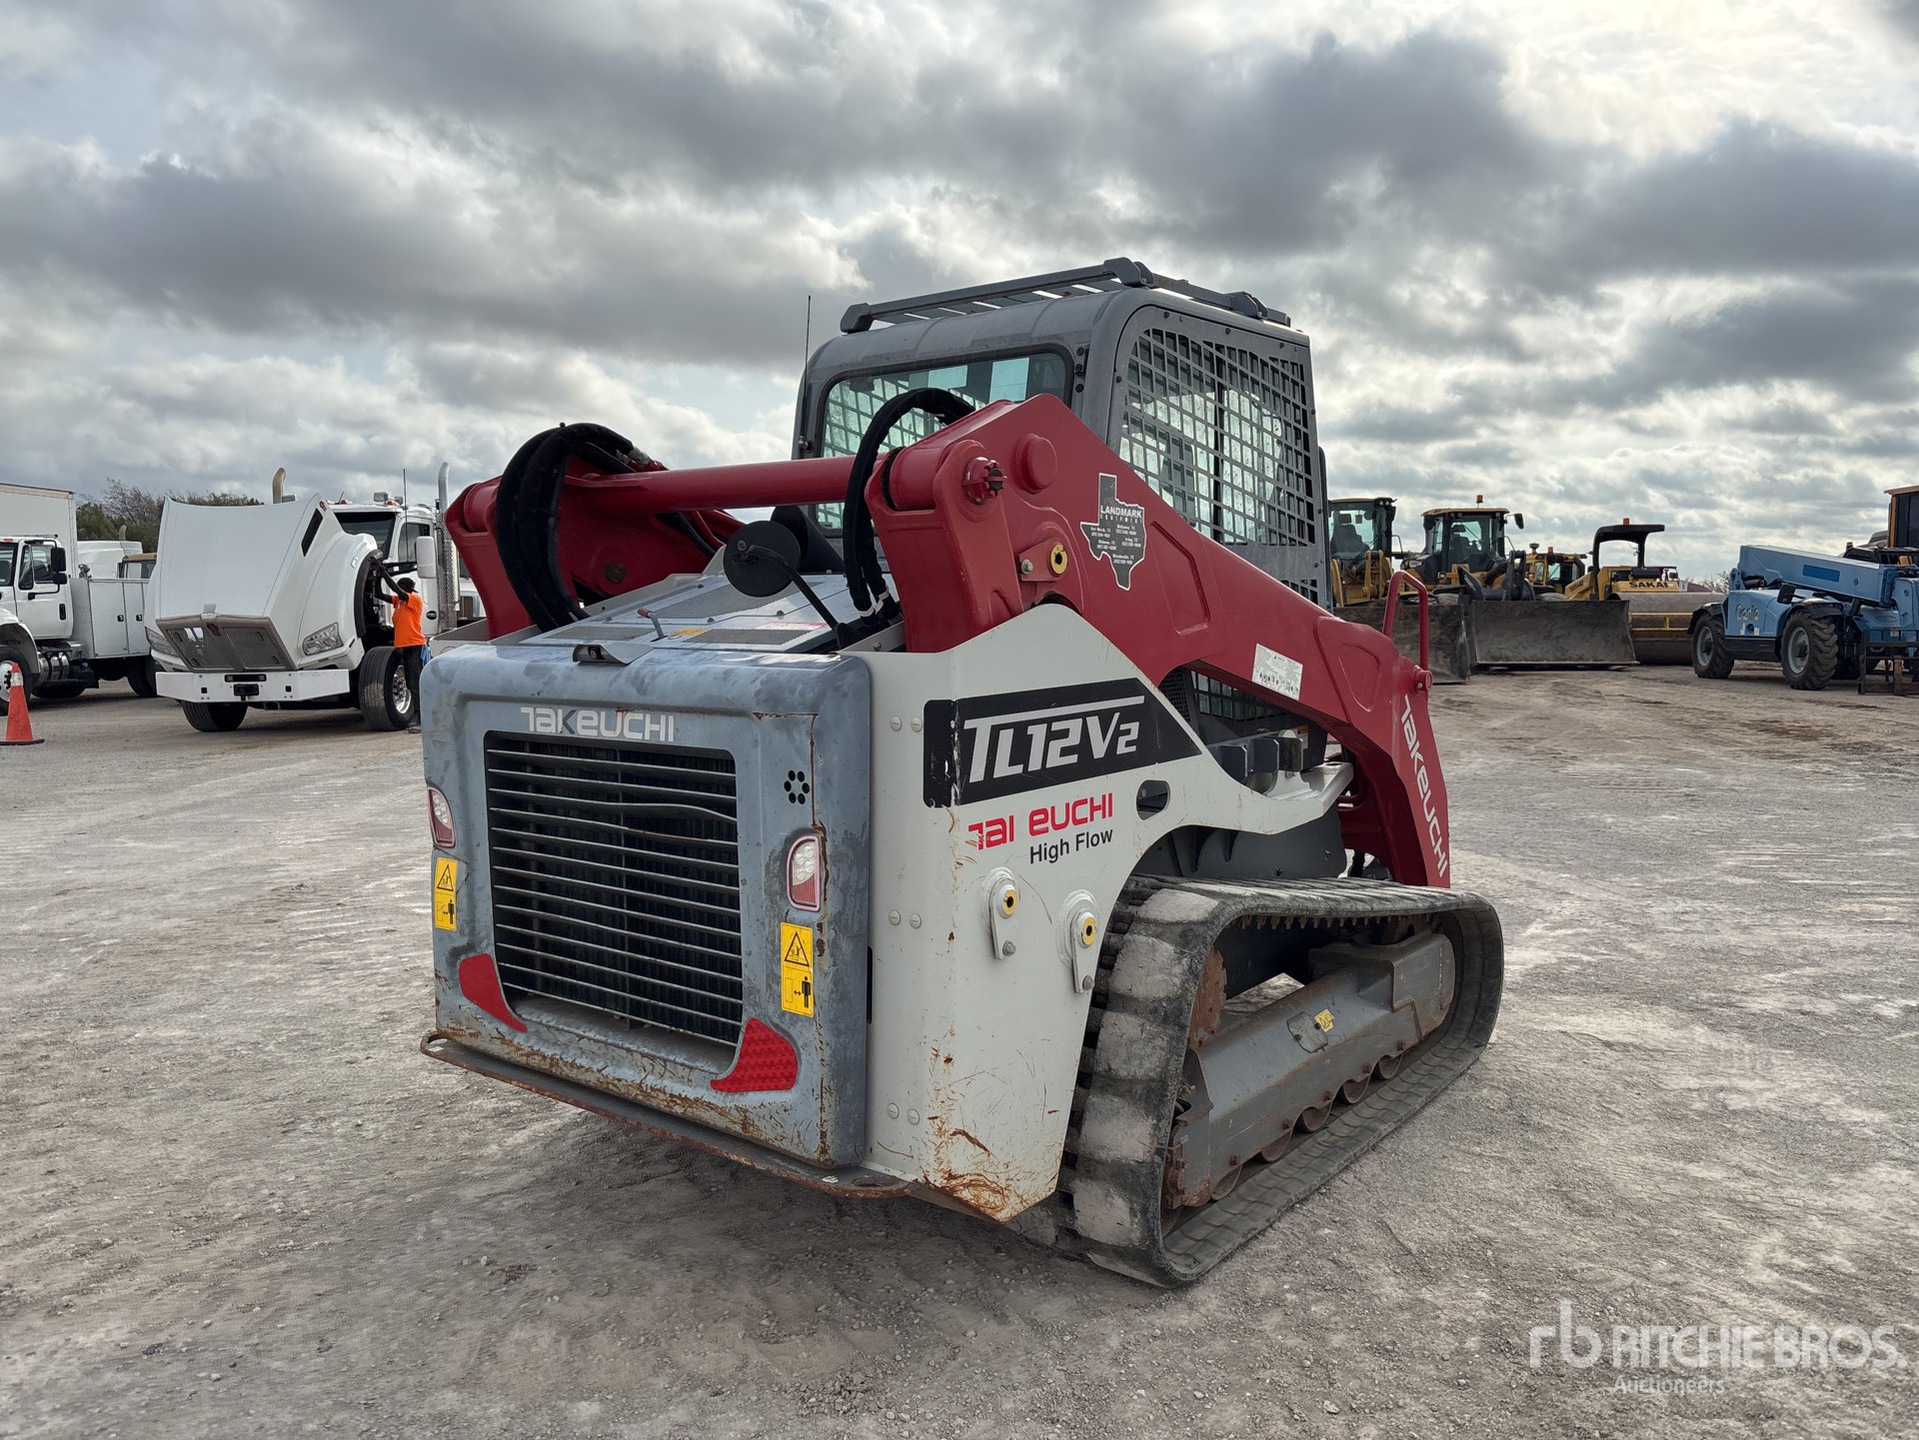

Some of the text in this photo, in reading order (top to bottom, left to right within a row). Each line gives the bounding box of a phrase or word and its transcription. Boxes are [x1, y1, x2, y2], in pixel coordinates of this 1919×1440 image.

[1100, 504, 1142, 519] LANDMARK
[1629, 580, 1669, 589] SAKAI
[1735, 603, 1760, 621] Genie
[1030, 828, 1113, 864] High Flow
